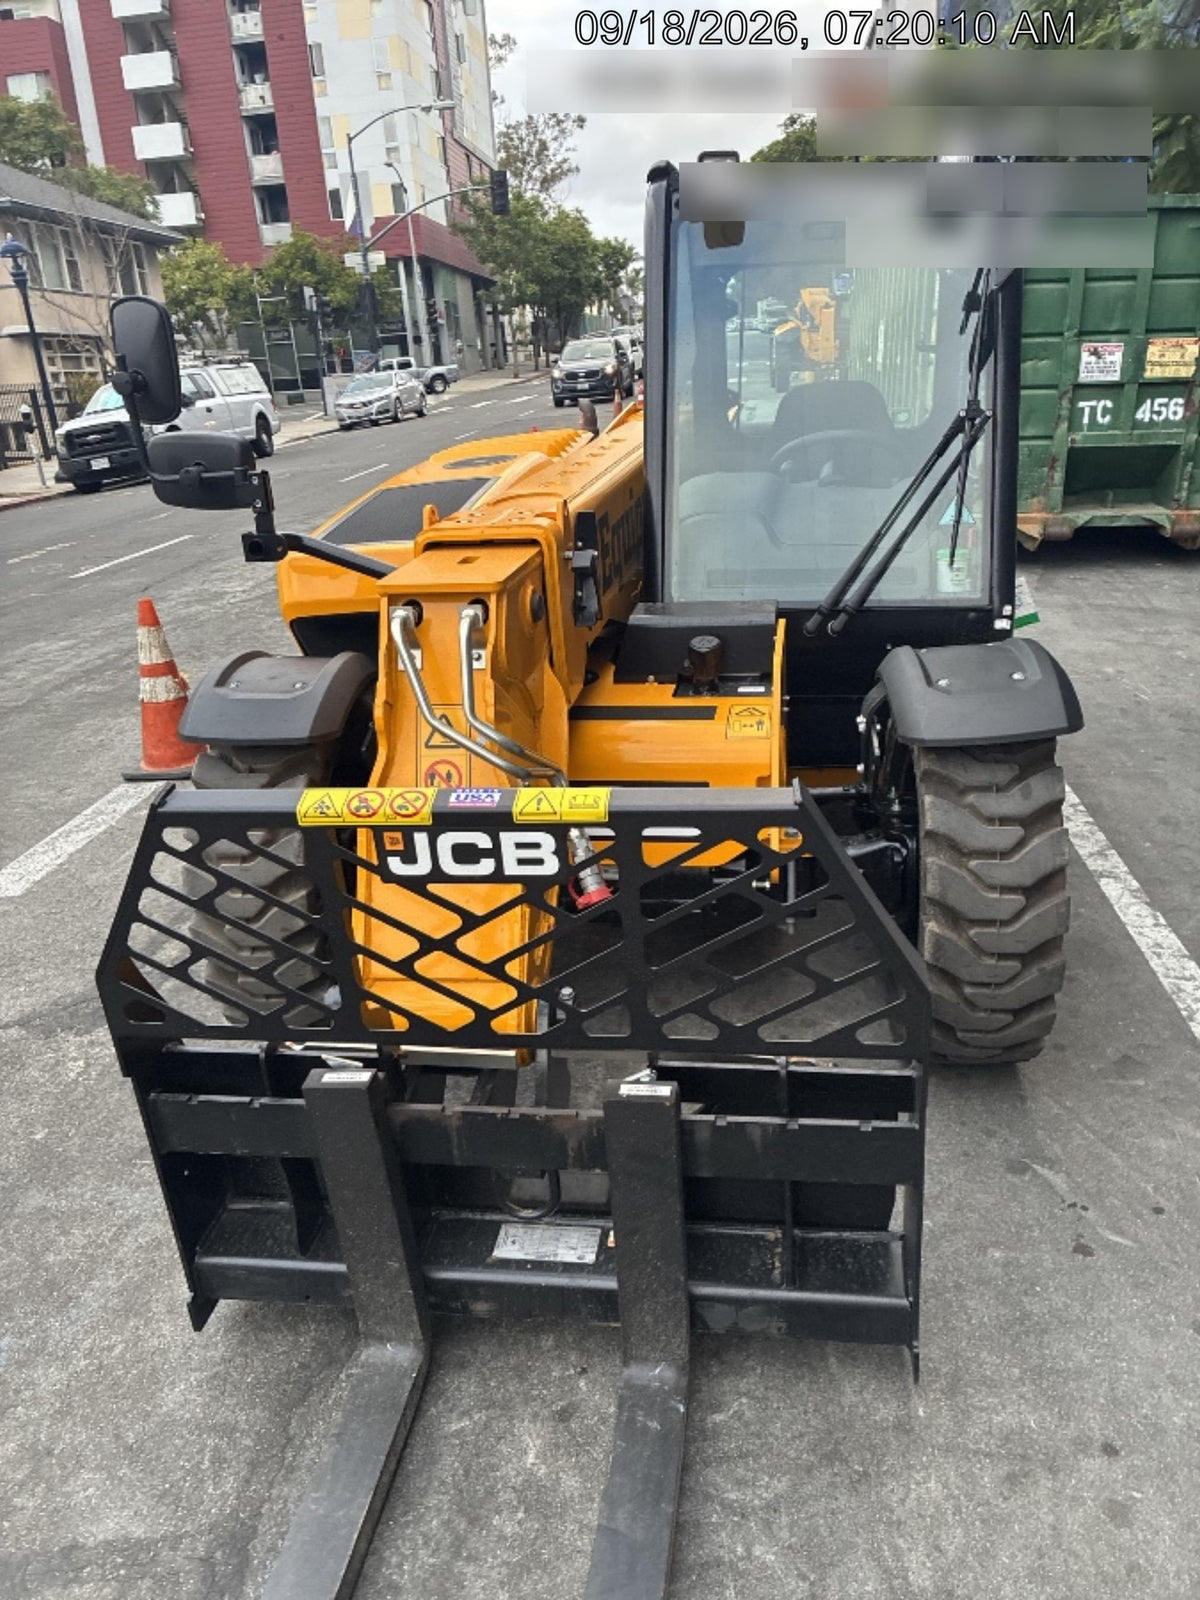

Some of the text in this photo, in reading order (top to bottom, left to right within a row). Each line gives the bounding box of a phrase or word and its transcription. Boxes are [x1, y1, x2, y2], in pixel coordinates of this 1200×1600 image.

[1078, 397, 1185, 425] TC 456
[387, 831, 560, 876] JCB
